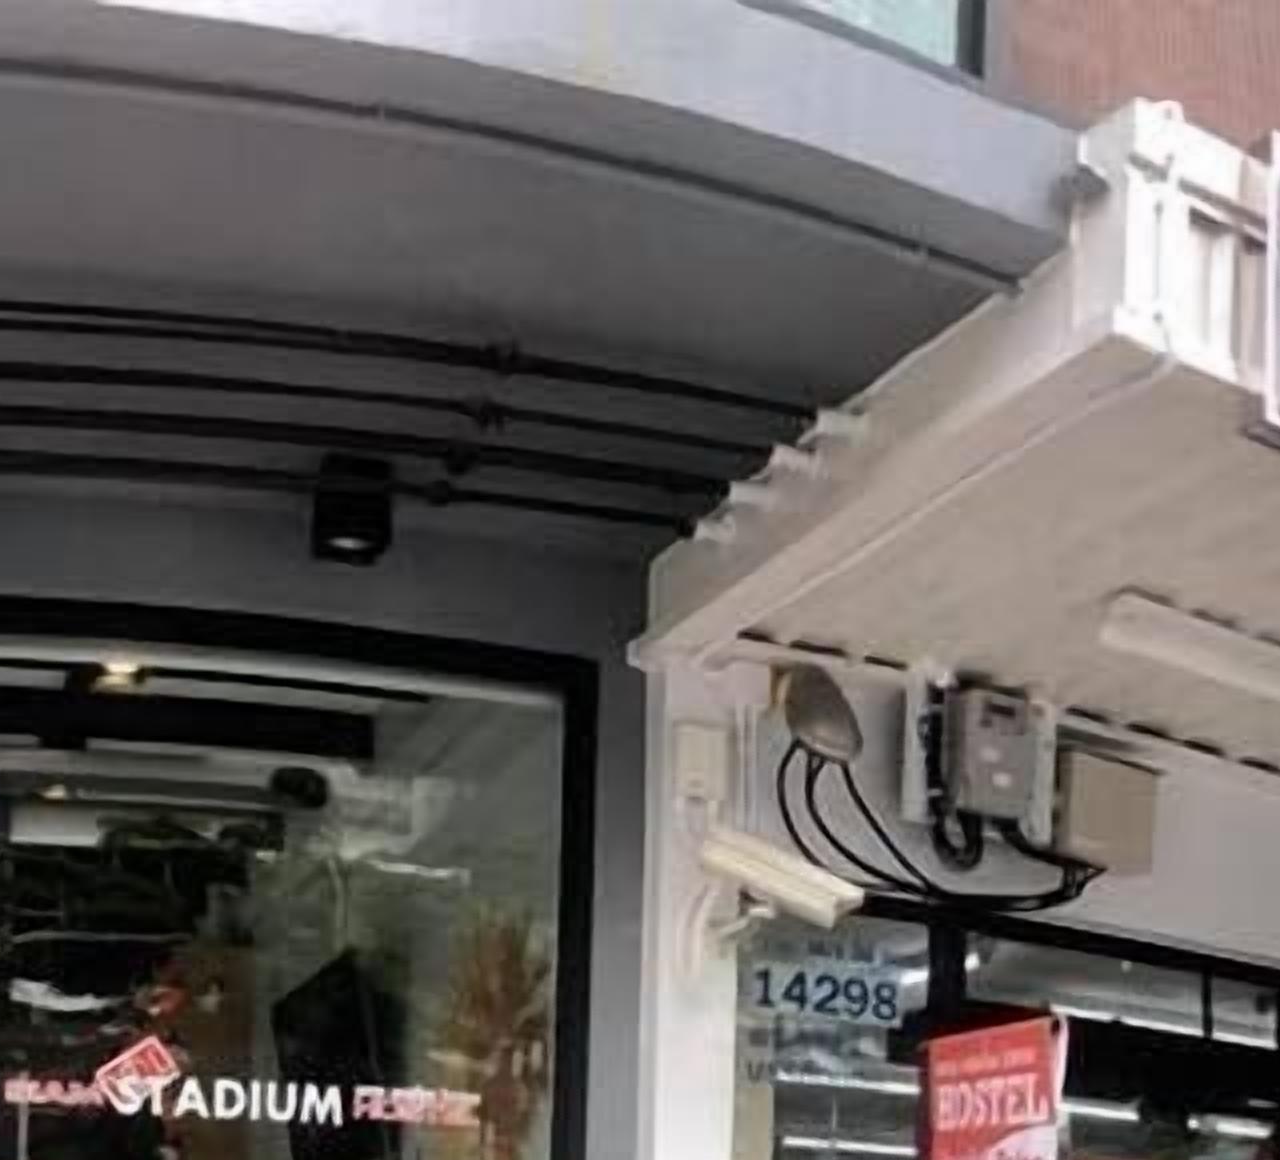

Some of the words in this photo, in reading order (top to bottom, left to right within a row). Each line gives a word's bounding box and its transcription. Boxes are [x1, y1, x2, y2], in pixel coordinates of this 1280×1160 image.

[754, 966, 898, 1021] 14298
[118, 1076, 343, 1127] STADIUM
[935, 1072, 1050, 1132] HOSTEL
